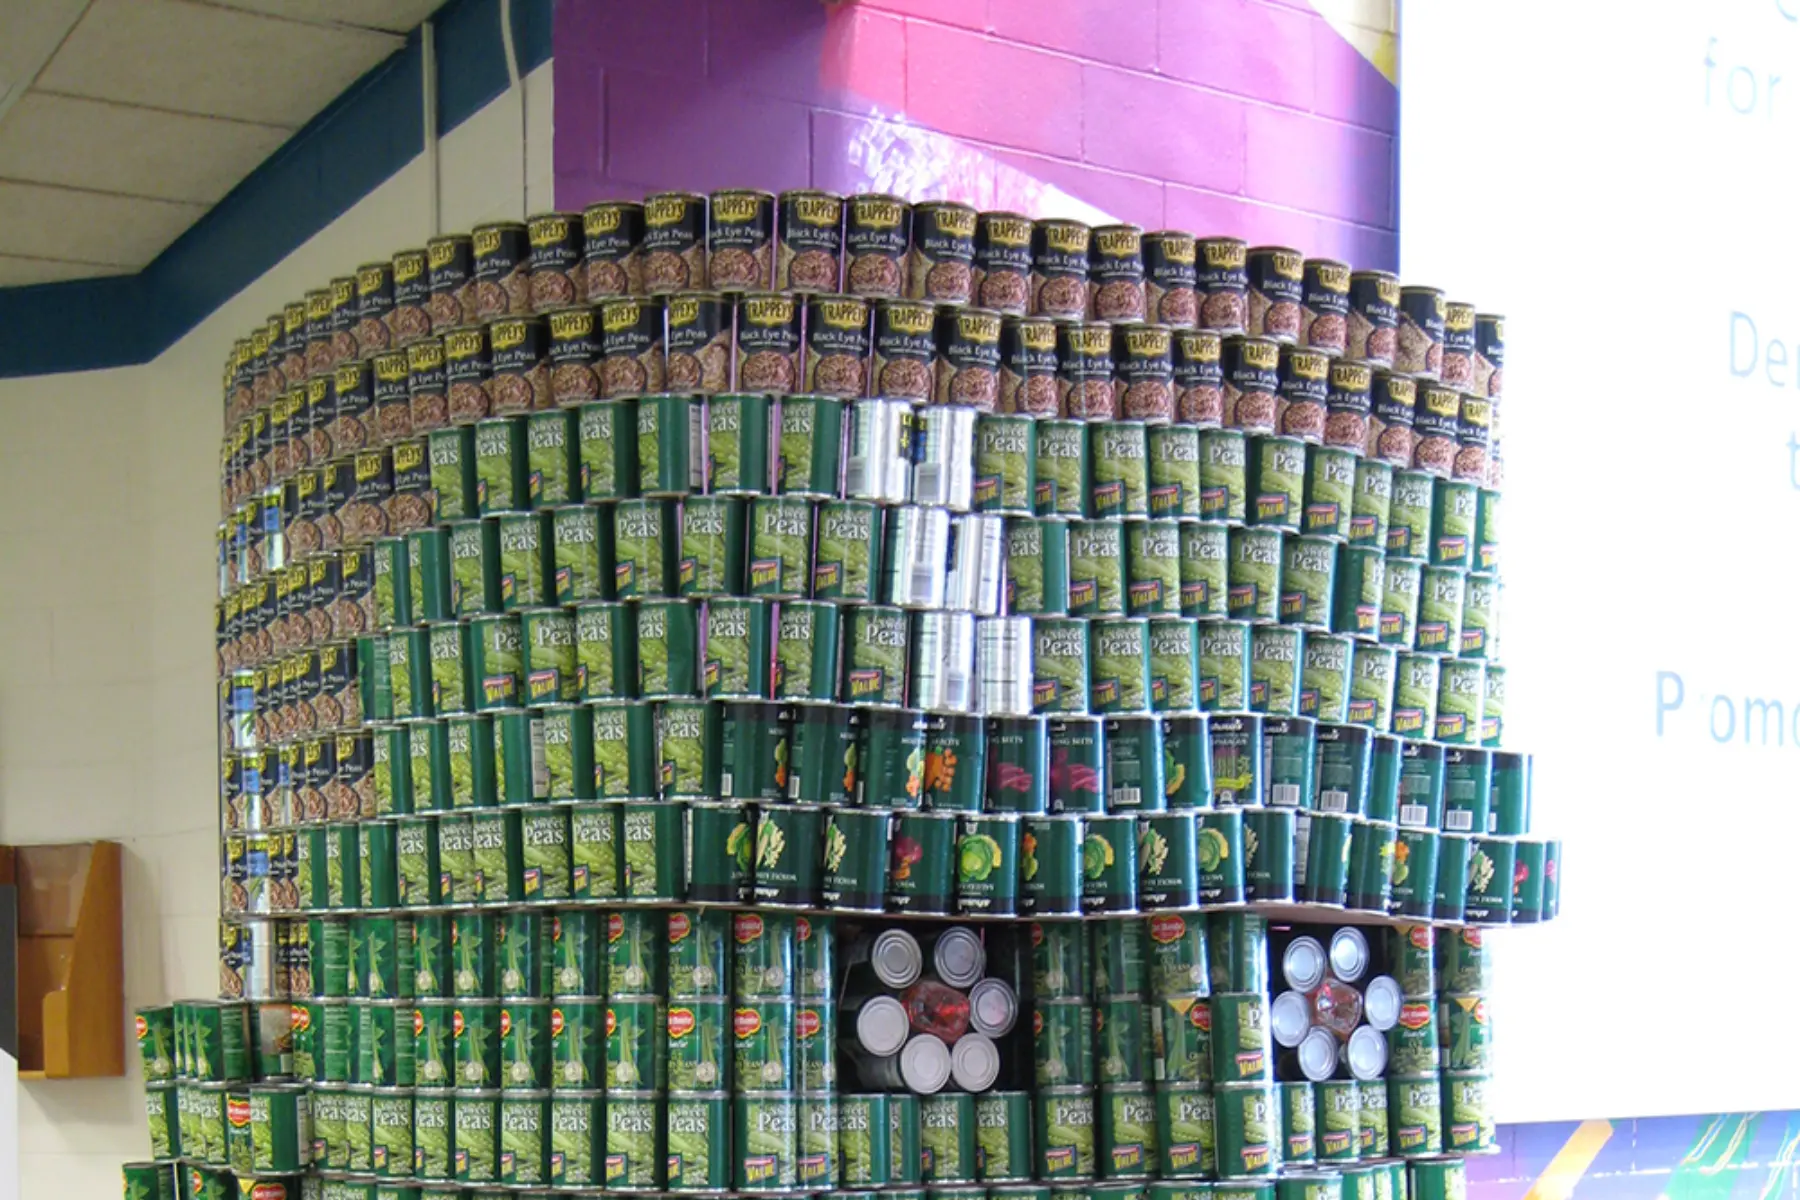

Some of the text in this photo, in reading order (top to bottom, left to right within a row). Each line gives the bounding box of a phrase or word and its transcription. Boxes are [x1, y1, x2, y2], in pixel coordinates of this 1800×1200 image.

[981, 432, 1027, 454] Peas
[1037, 437, 1079, 458] Peas
[1104, 440, 1145, 459] Peas
[1393, 487, 1429, 507] Peas
[618, 519, 658, 538] Peas
[683, 516, 723, 534] Peas
[764, 515, 807, 537] Peas
[825, 517, 869, 539] Peas
[1077, 537, 1120, 558] Peas
[1142, 537, 1180, 558] Peas
[1241, 544, 1279, 565] Peas
[1291, 551, 1330, 571] Peas
[866, 624, 906, 647] Peas
[1039, 637, 1083, 657] Peas
[1101, 637, 1141, 656] Peas
[1151, 637, 1189, 655] Peas
[1200, 638, 1241, 657] Peas
[1253, 640, 1295, 661] Peas
[1305, 649, 1344, 671] Peas
[525, 826, 564, 845] Peas
[574, 823, 611, 842] Peas
[456, 1112, 490, 1130] Peas
[612, 1113, 652, 1133] Peas
[759, 1112, 796, 1132] Peas
[1056, 1107, 1094, 1126] Peas
